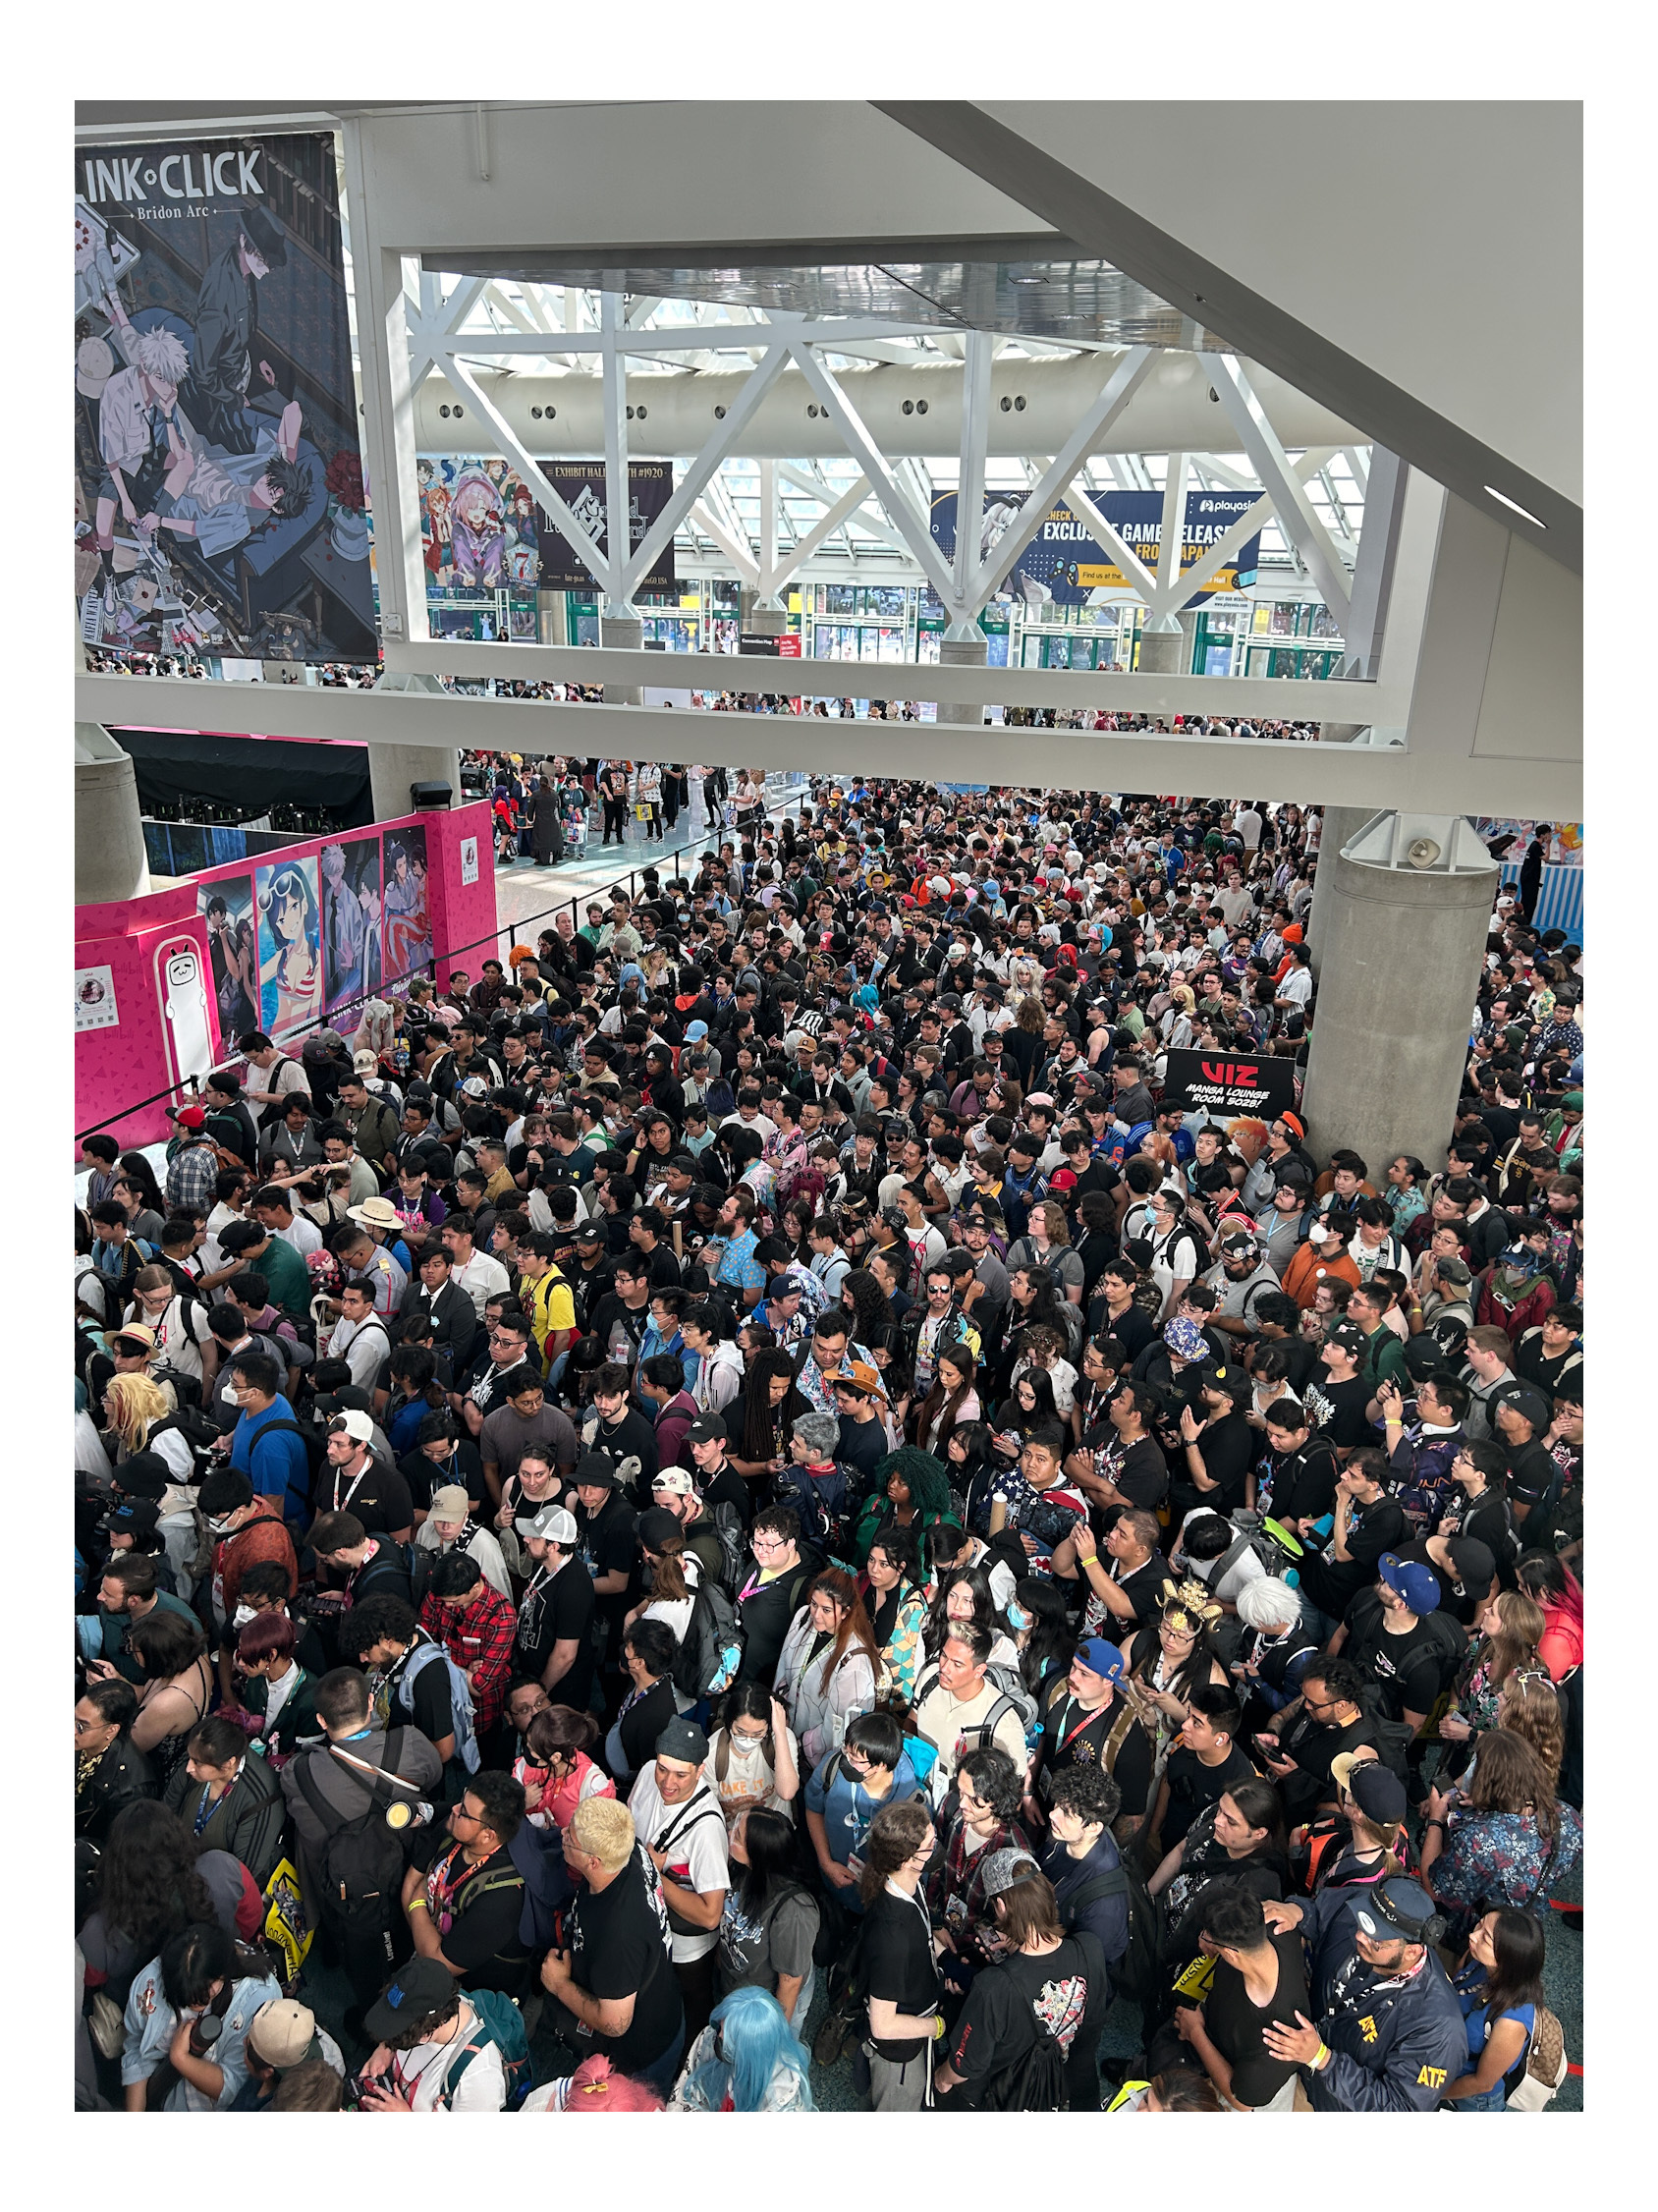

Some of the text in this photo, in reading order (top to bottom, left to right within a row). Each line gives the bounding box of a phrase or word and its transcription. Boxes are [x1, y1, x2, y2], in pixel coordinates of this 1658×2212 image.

[159, 150, 264, 198] CLICK
[138, 204, 209, 220] Bridon Arc
[555, 467, 586, 477] EXHIBIT
[638, 468, 663, 478] #1920
[1135, 543, 1212, 561] FRO APA
[1201, 1061, 1259, 1087] VIZ
[1185, 1083, 1271, 1100] MANGA LOUNGE
[1191, 1093, 1263, 1109] ROOM 502B!
[1357, 2015, 1379, 2044] ATF
[1416, 2065, 1448, 2090] ATF
